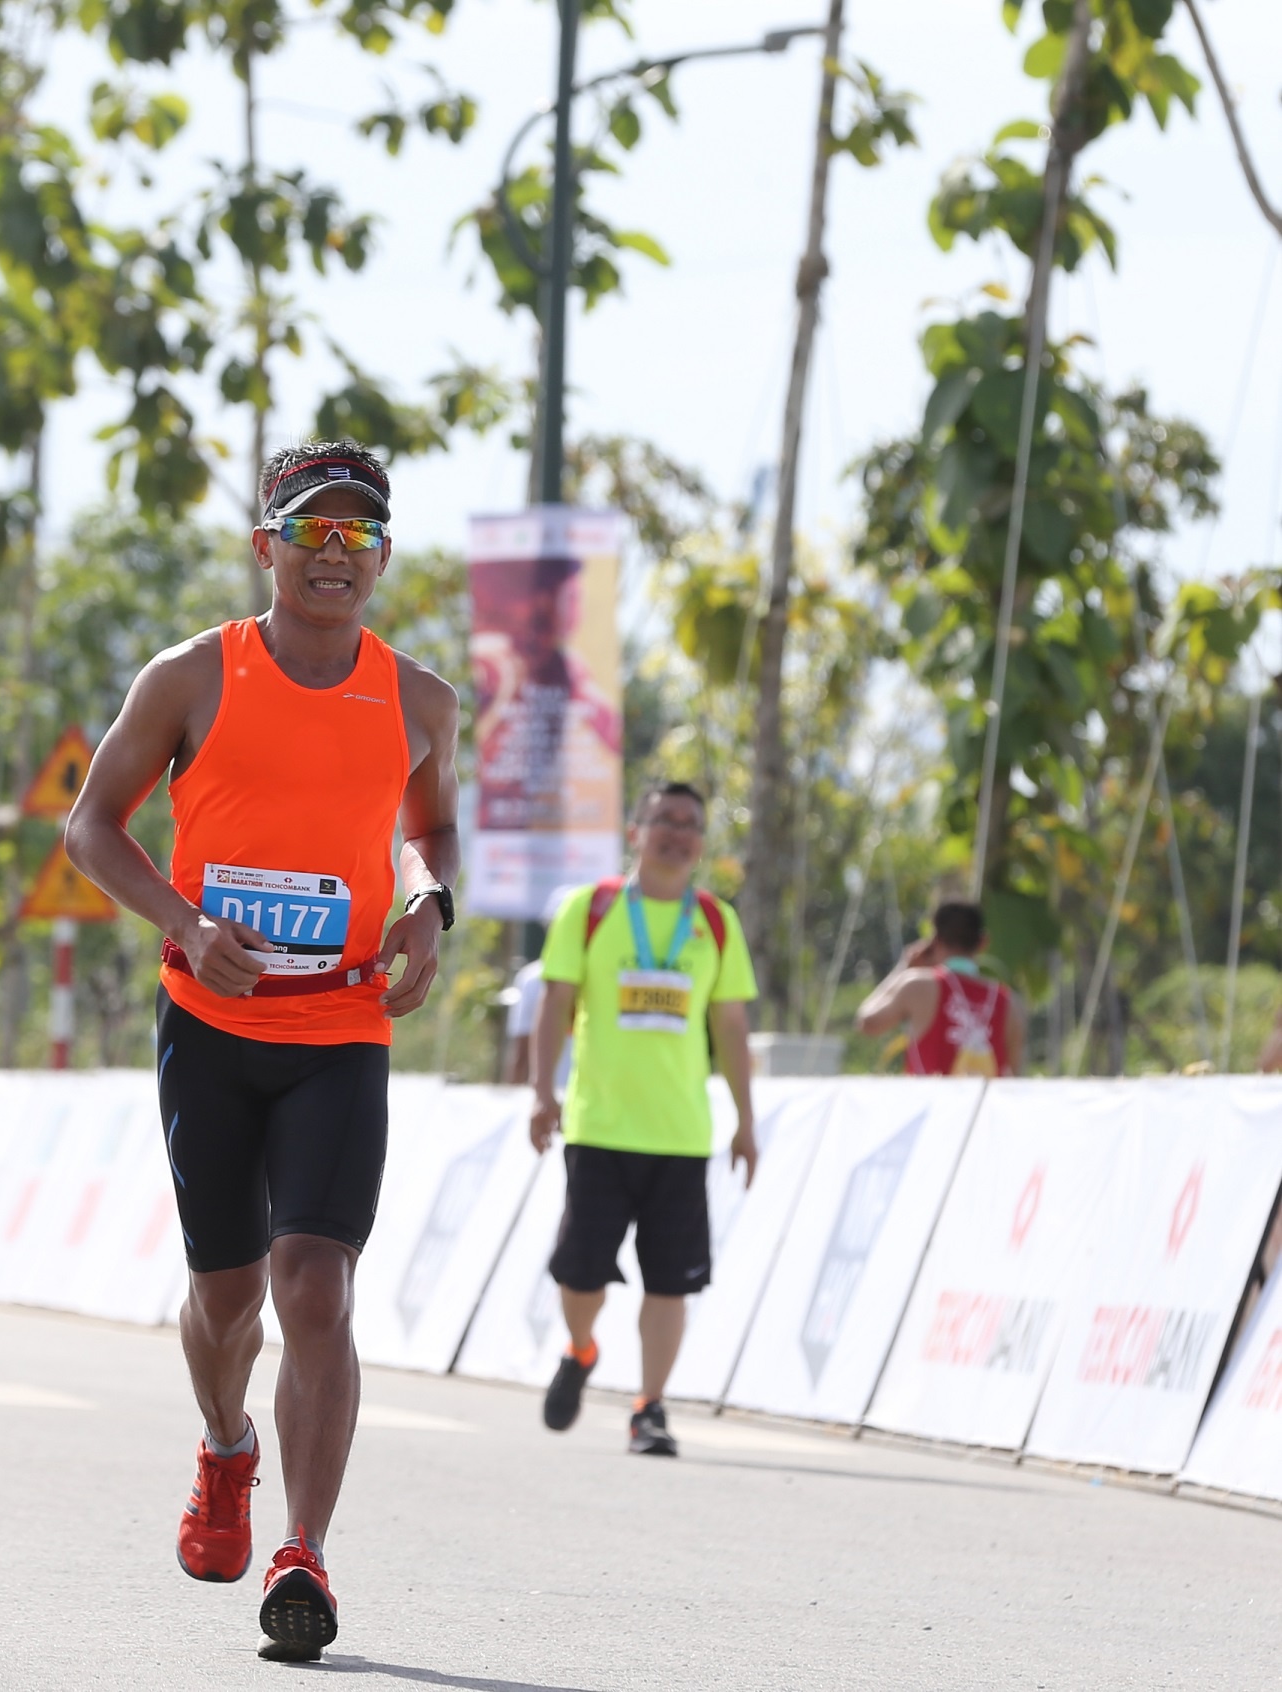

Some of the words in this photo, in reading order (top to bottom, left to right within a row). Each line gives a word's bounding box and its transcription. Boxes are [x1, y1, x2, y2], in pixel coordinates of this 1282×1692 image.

[231, 878, 263, 887] MARATHON
[265, 883, 310, 891] TECHCOMBANK
[221, 897, 331, 940] D1177
